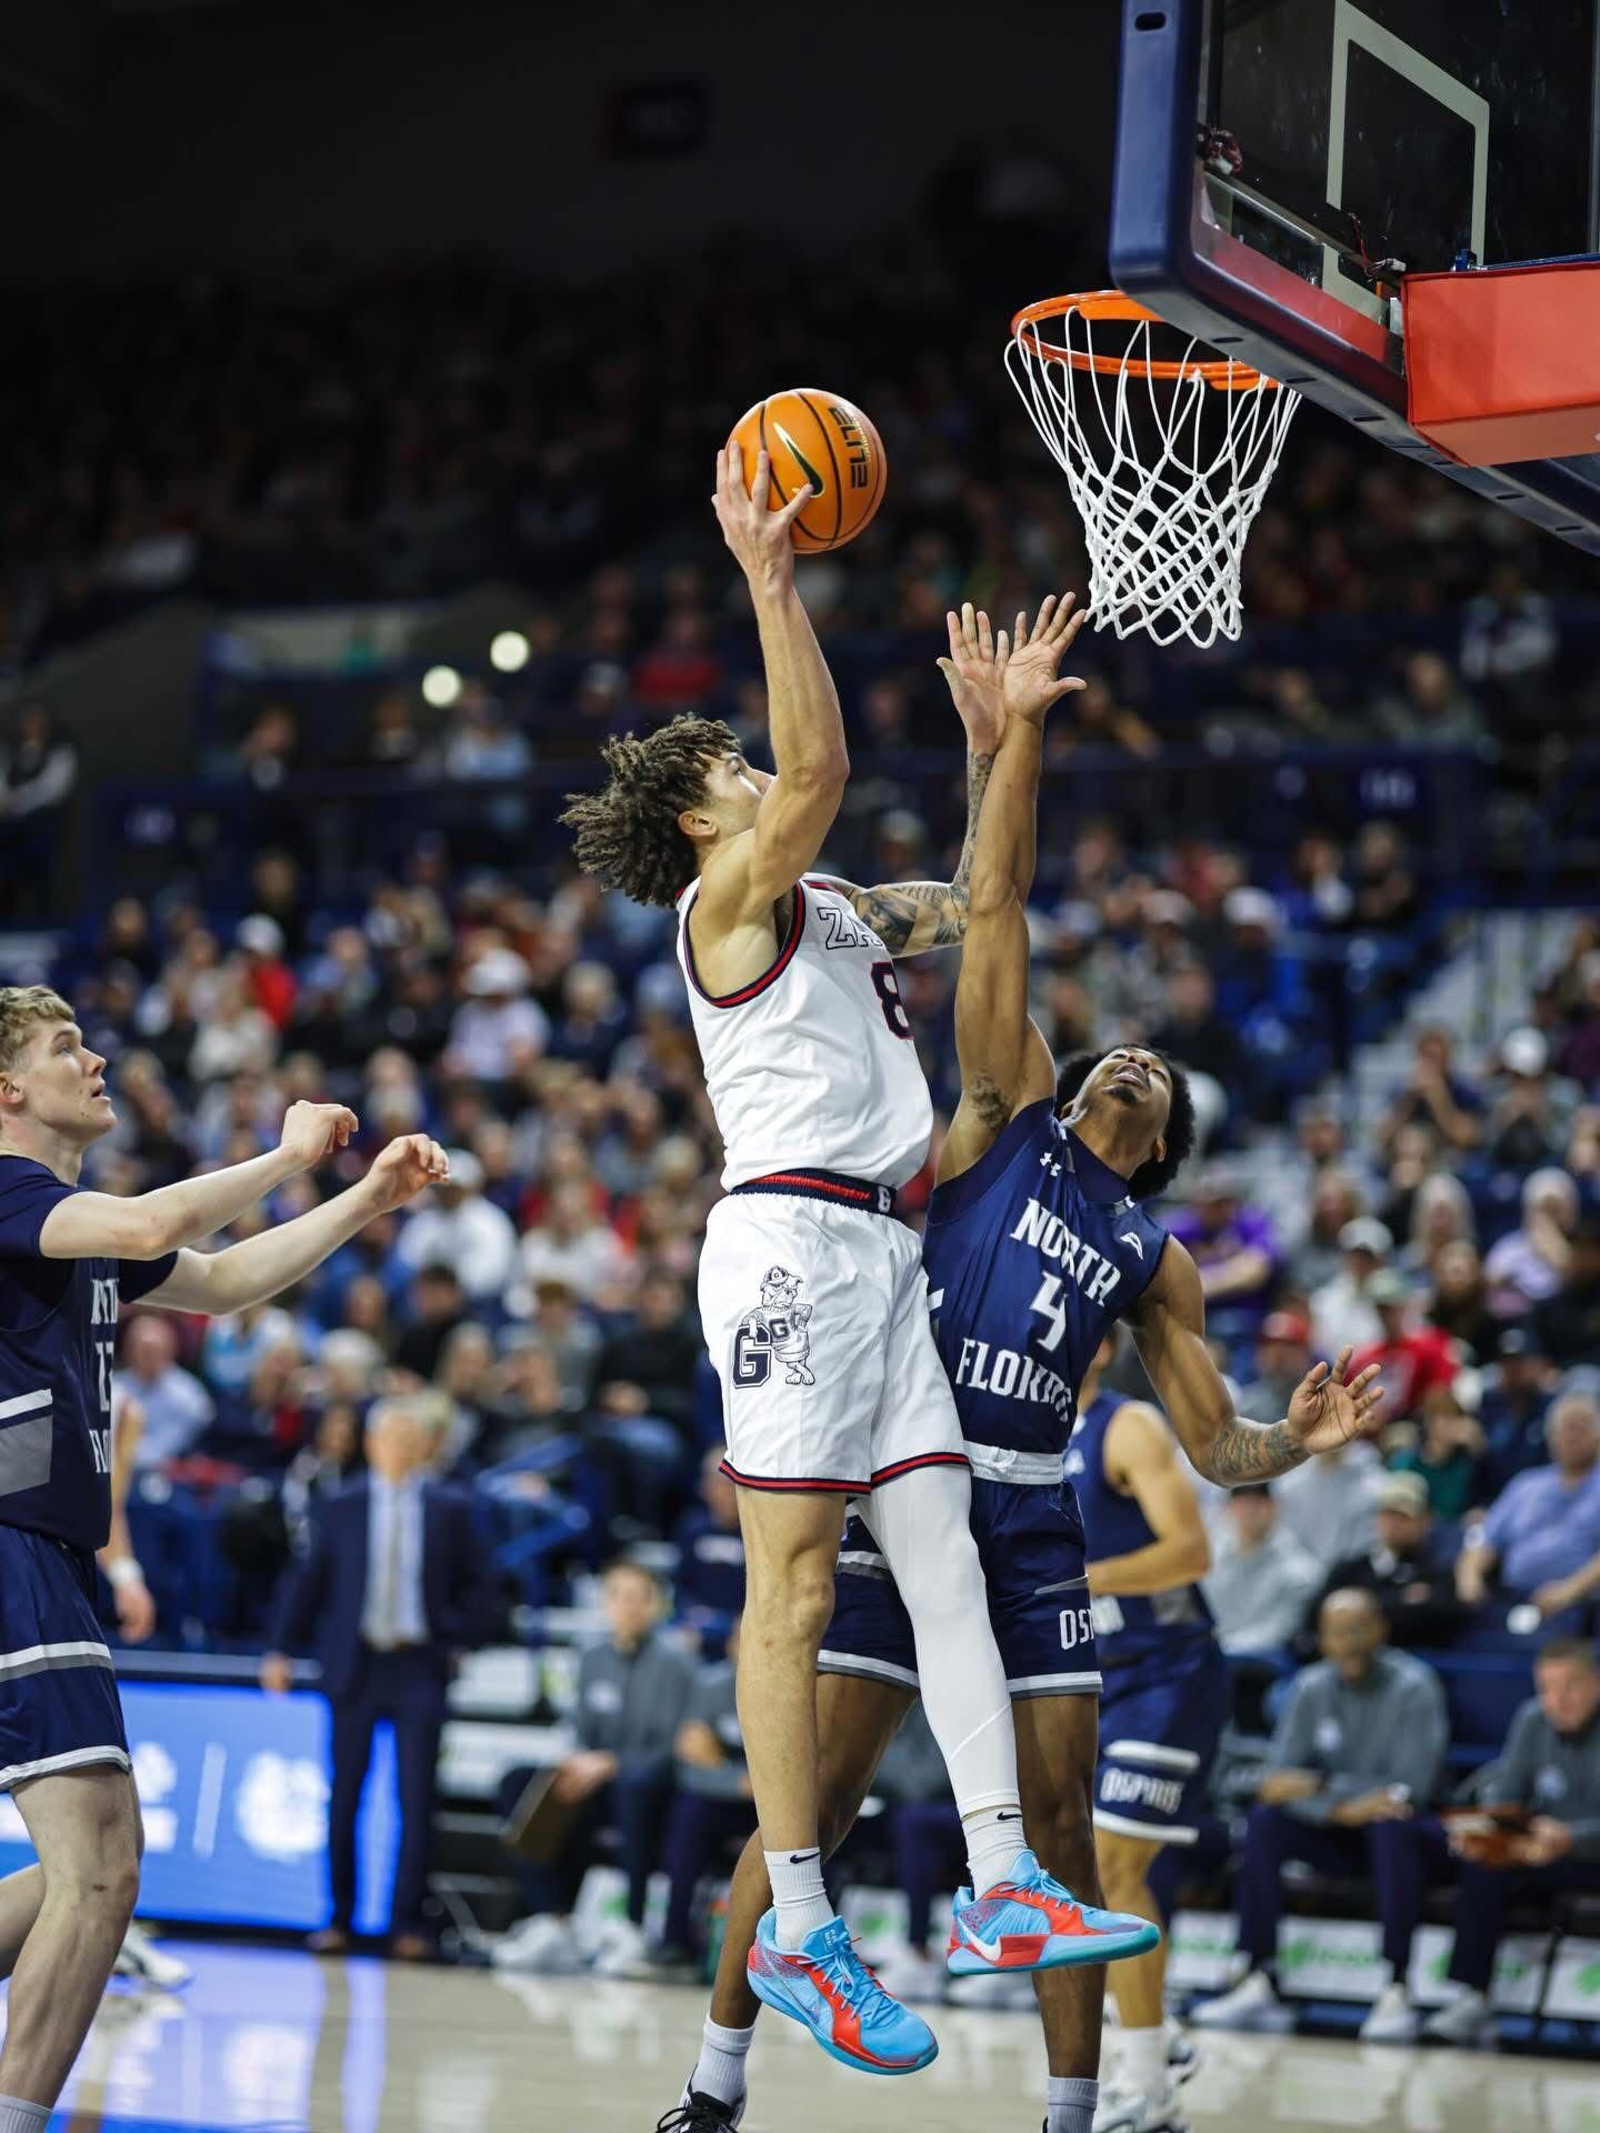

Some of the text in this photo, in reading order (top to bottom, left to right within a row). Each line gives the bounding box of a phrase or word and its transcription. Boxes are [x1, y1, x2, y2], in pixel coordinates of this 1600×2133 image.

[828, 407, 869, 488] ELITE
[870, 961, 913, 1040] 8
[1009, 1197, 1122, 1307] NORTH
[769, 1318, 790, 1340] G
[1029, 1270, 1069, 1352] 4
[732, 1323, 772, 1390] G
